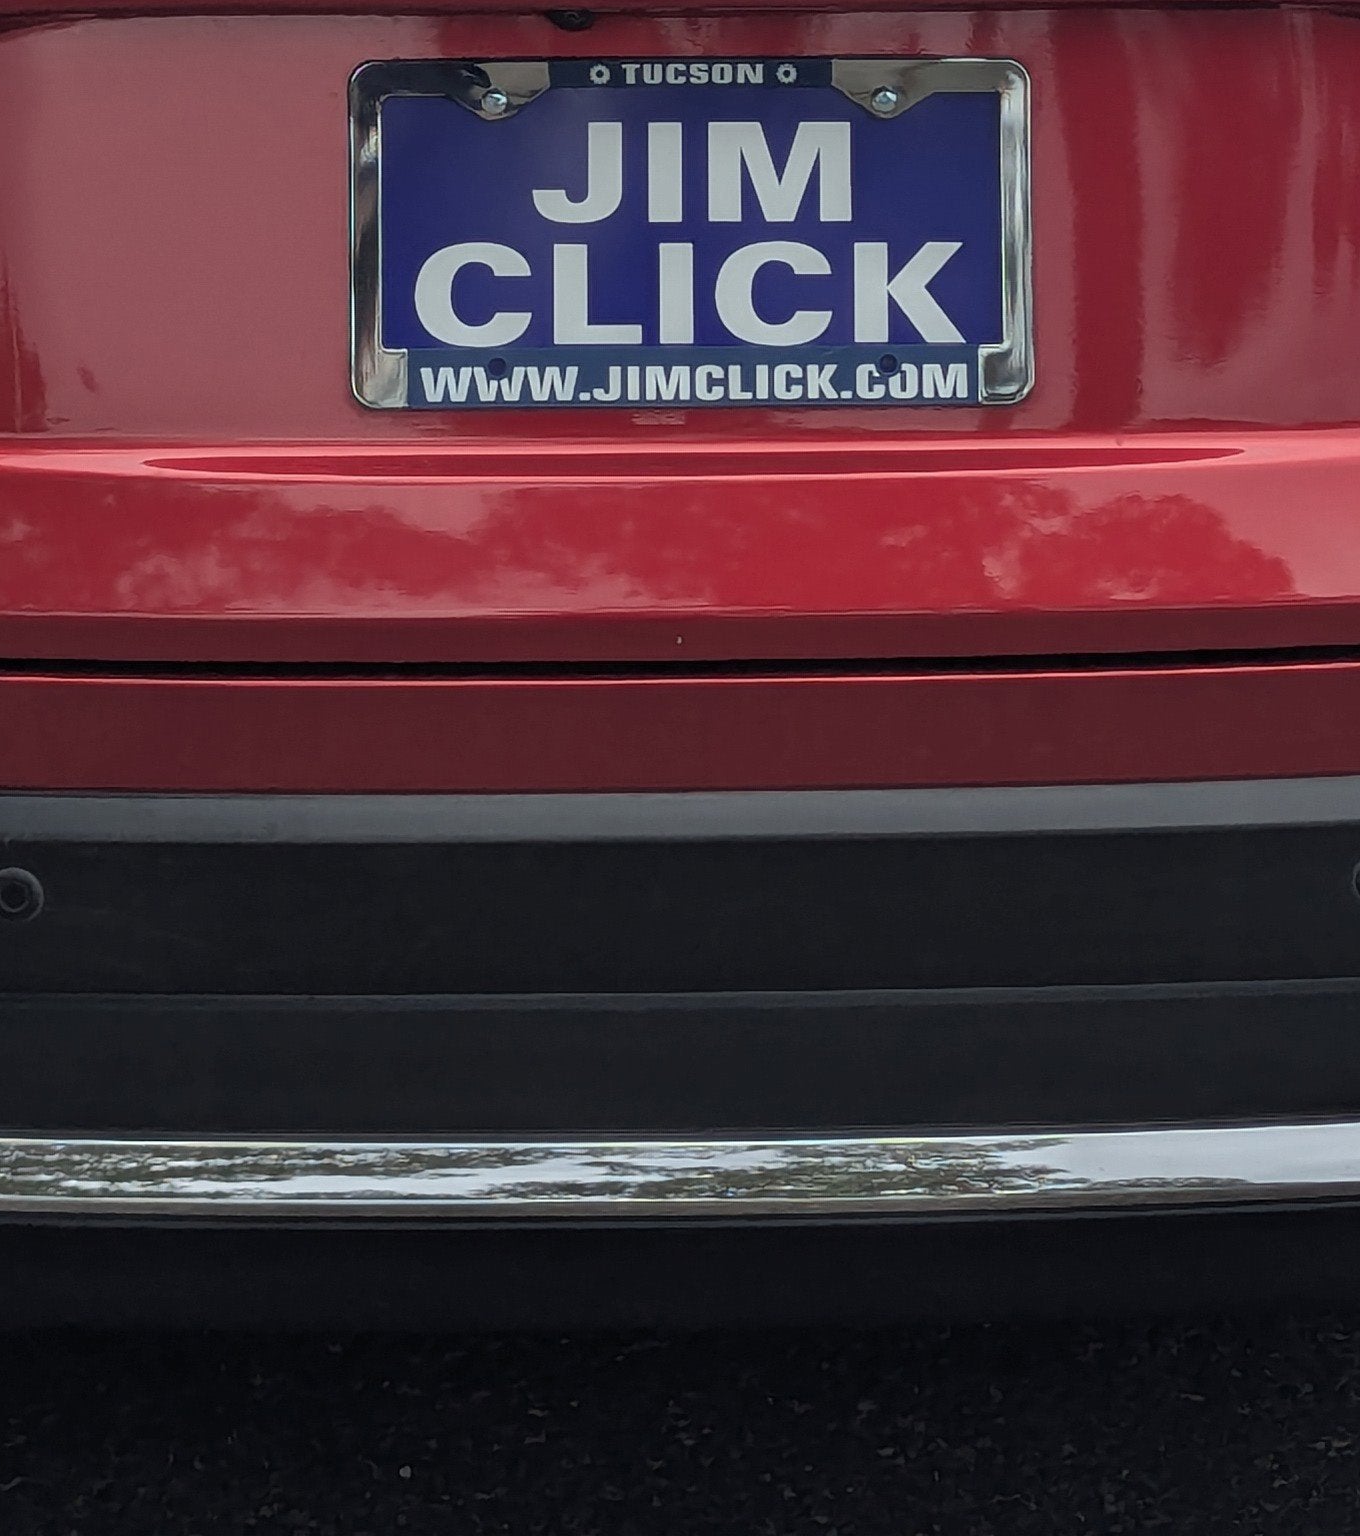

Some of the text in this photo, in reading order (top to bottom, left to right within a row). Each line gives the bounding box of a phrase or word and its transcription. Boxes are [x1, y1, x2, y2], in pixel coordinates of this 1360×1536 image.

[622, 64, 764, 85] TUCSON
[532, 122, 852, 222] JIM
[414, 241, 966, 346] CLICK
[420, 364, 968, 404] WWW.JIMCLICK.COM
